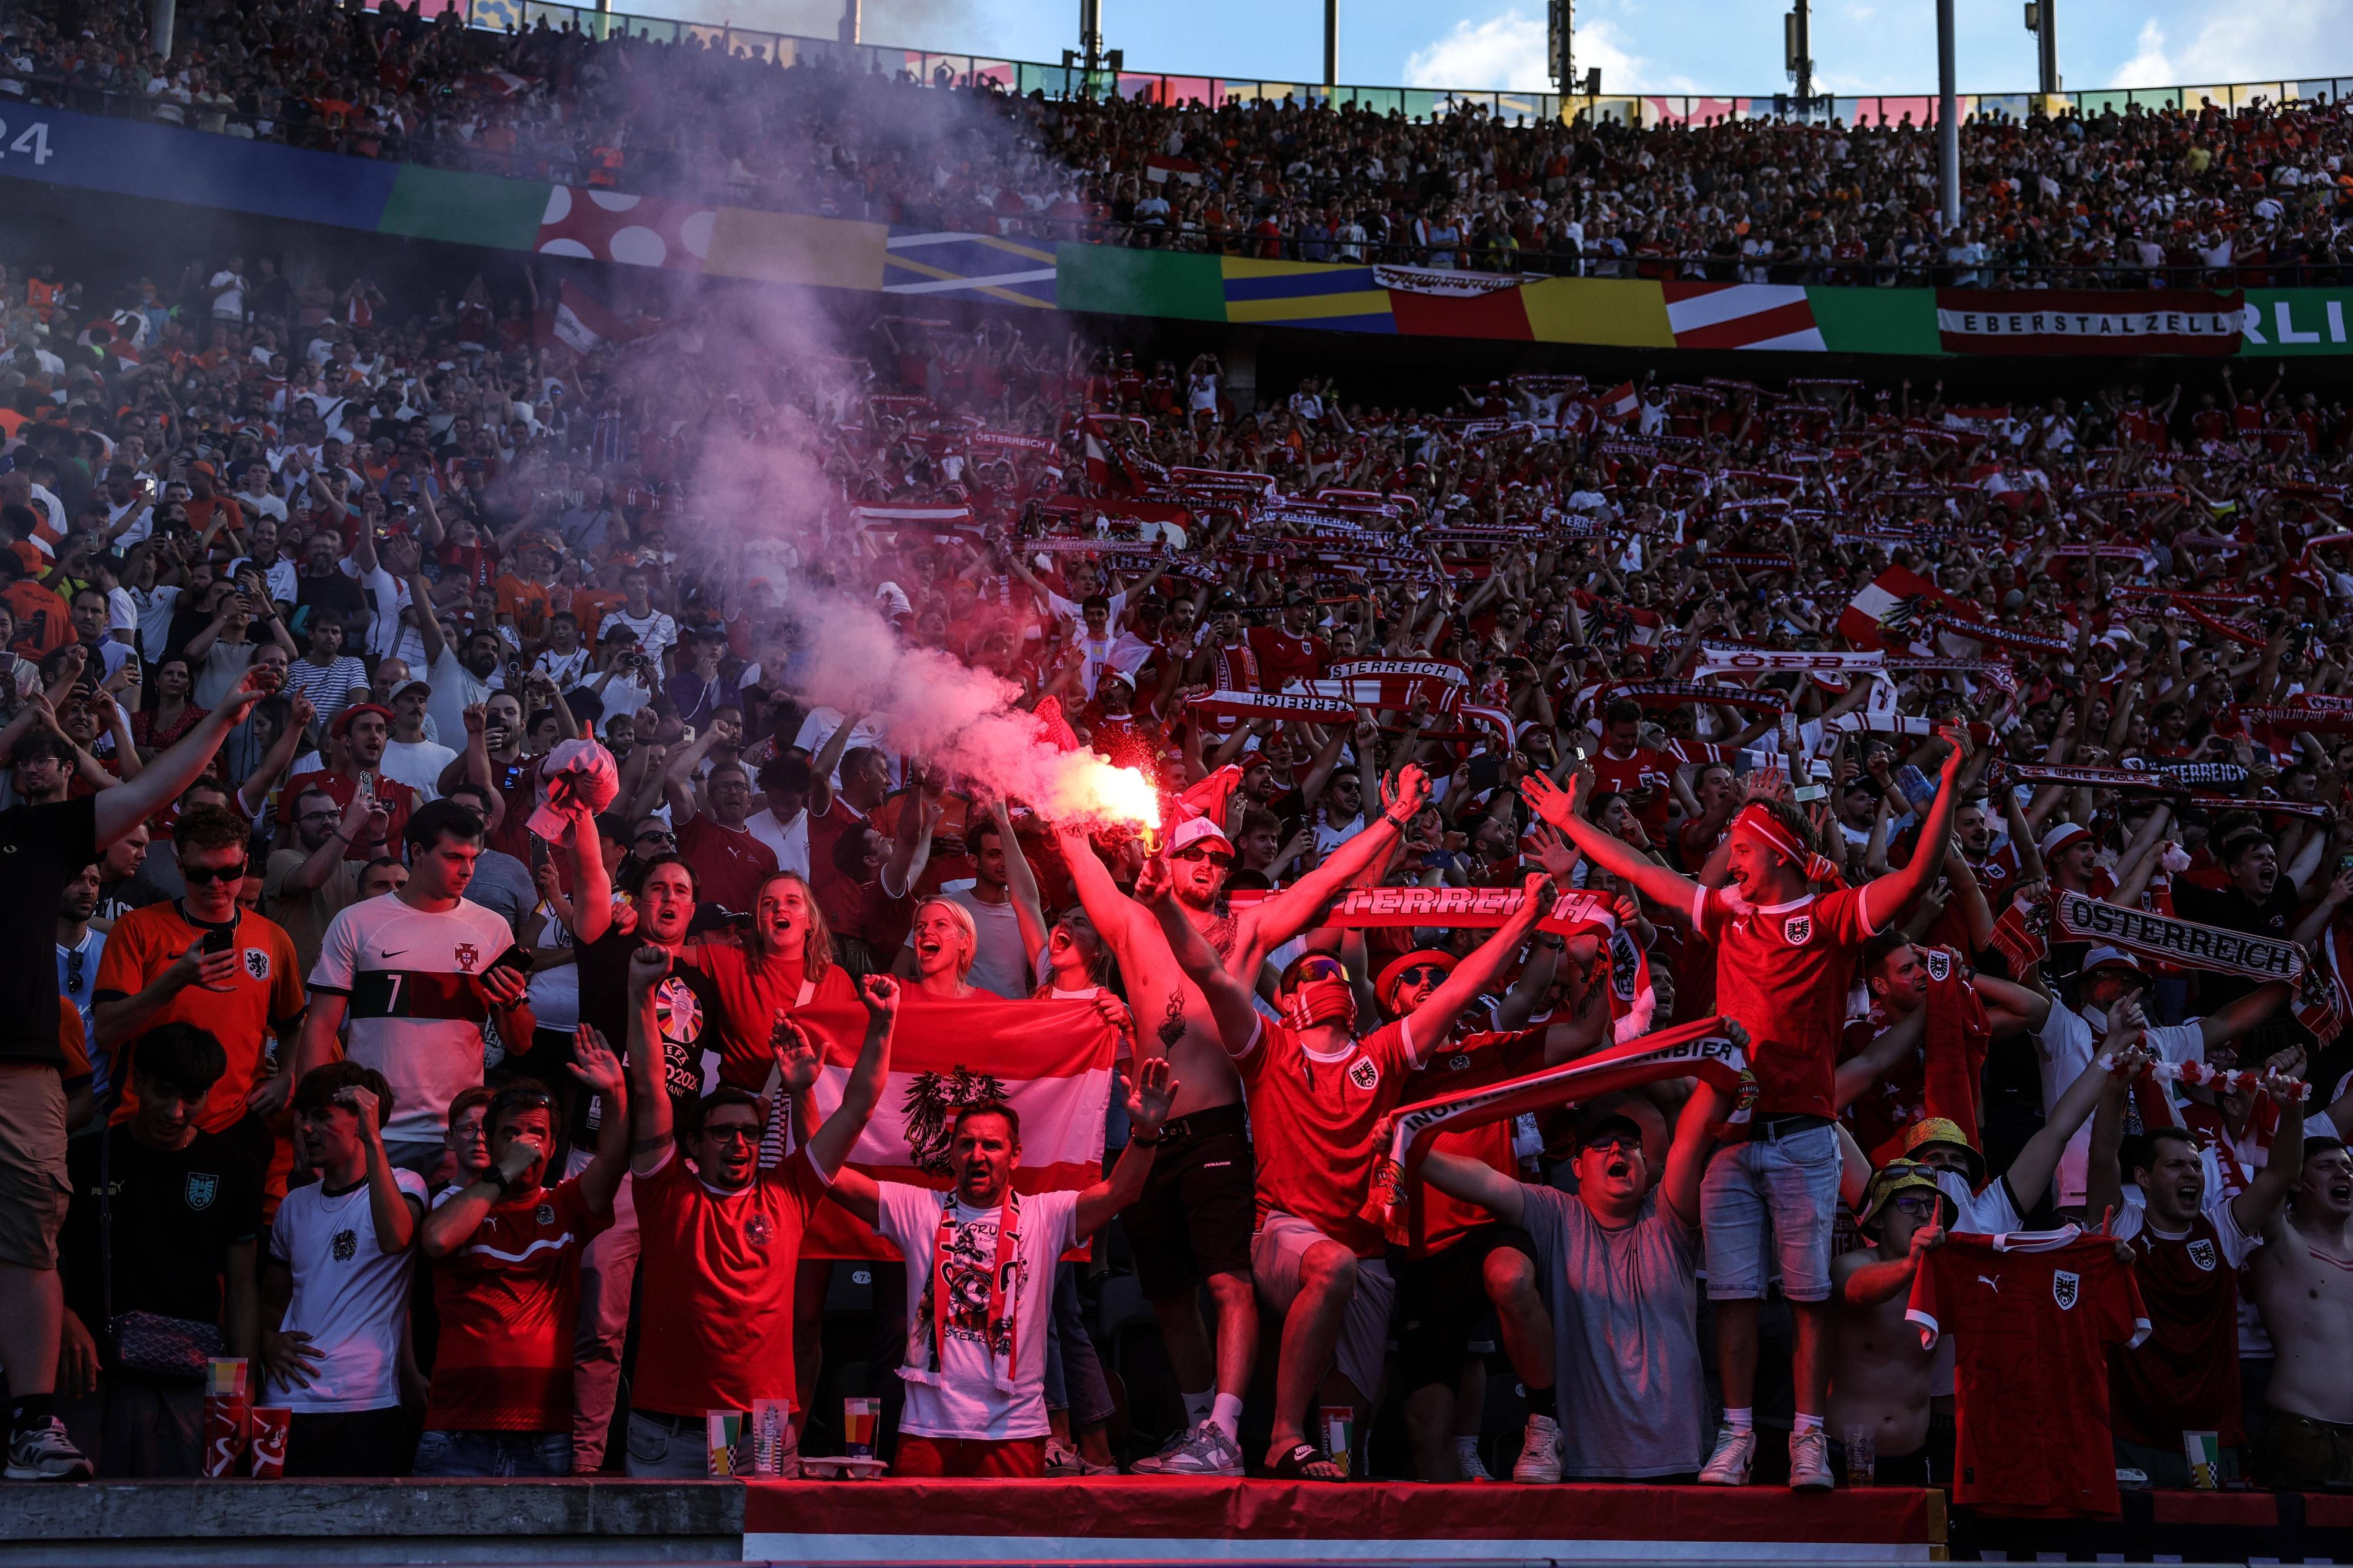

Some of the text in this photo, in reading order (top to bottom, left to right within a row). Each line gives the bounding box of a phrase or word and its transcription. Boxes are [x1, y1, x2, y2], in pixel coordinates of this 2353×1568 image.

[1964, 313, 2228, 333] EBERSTALZELL
[2242, 301, 2347, 345] RLI
[975, 432, 1046, 449] ÖSTERREICH
[1601, 443, 1659, 458] STERREICH
[1028, 539, 1149, 552] Hurricanes Österreich
[1999, 630, 2061, 647] ÖSTERREICH
[1730, 653, 1844, 668] ÖFB
[1329, 661, 1449, 679] STERREICH
[1254, 693, 1349, 712] TERREICH
[2055, 768, 2092, 779] WHITE
[2099, 772, 2152, 783] EAGLES
[2071, 896, 2292, 974] ÖSTERREICH
[386, 974, 402, 1013] 7
[666, 1045, 687, 1065] EFA
[91, 1186, 116, 1196] PUA
[945, 1329, 986, 1344] STERR
[756, 1419, 776, 1474] Bitburger
[1295, 1444, 1314, 1456] NIKE
